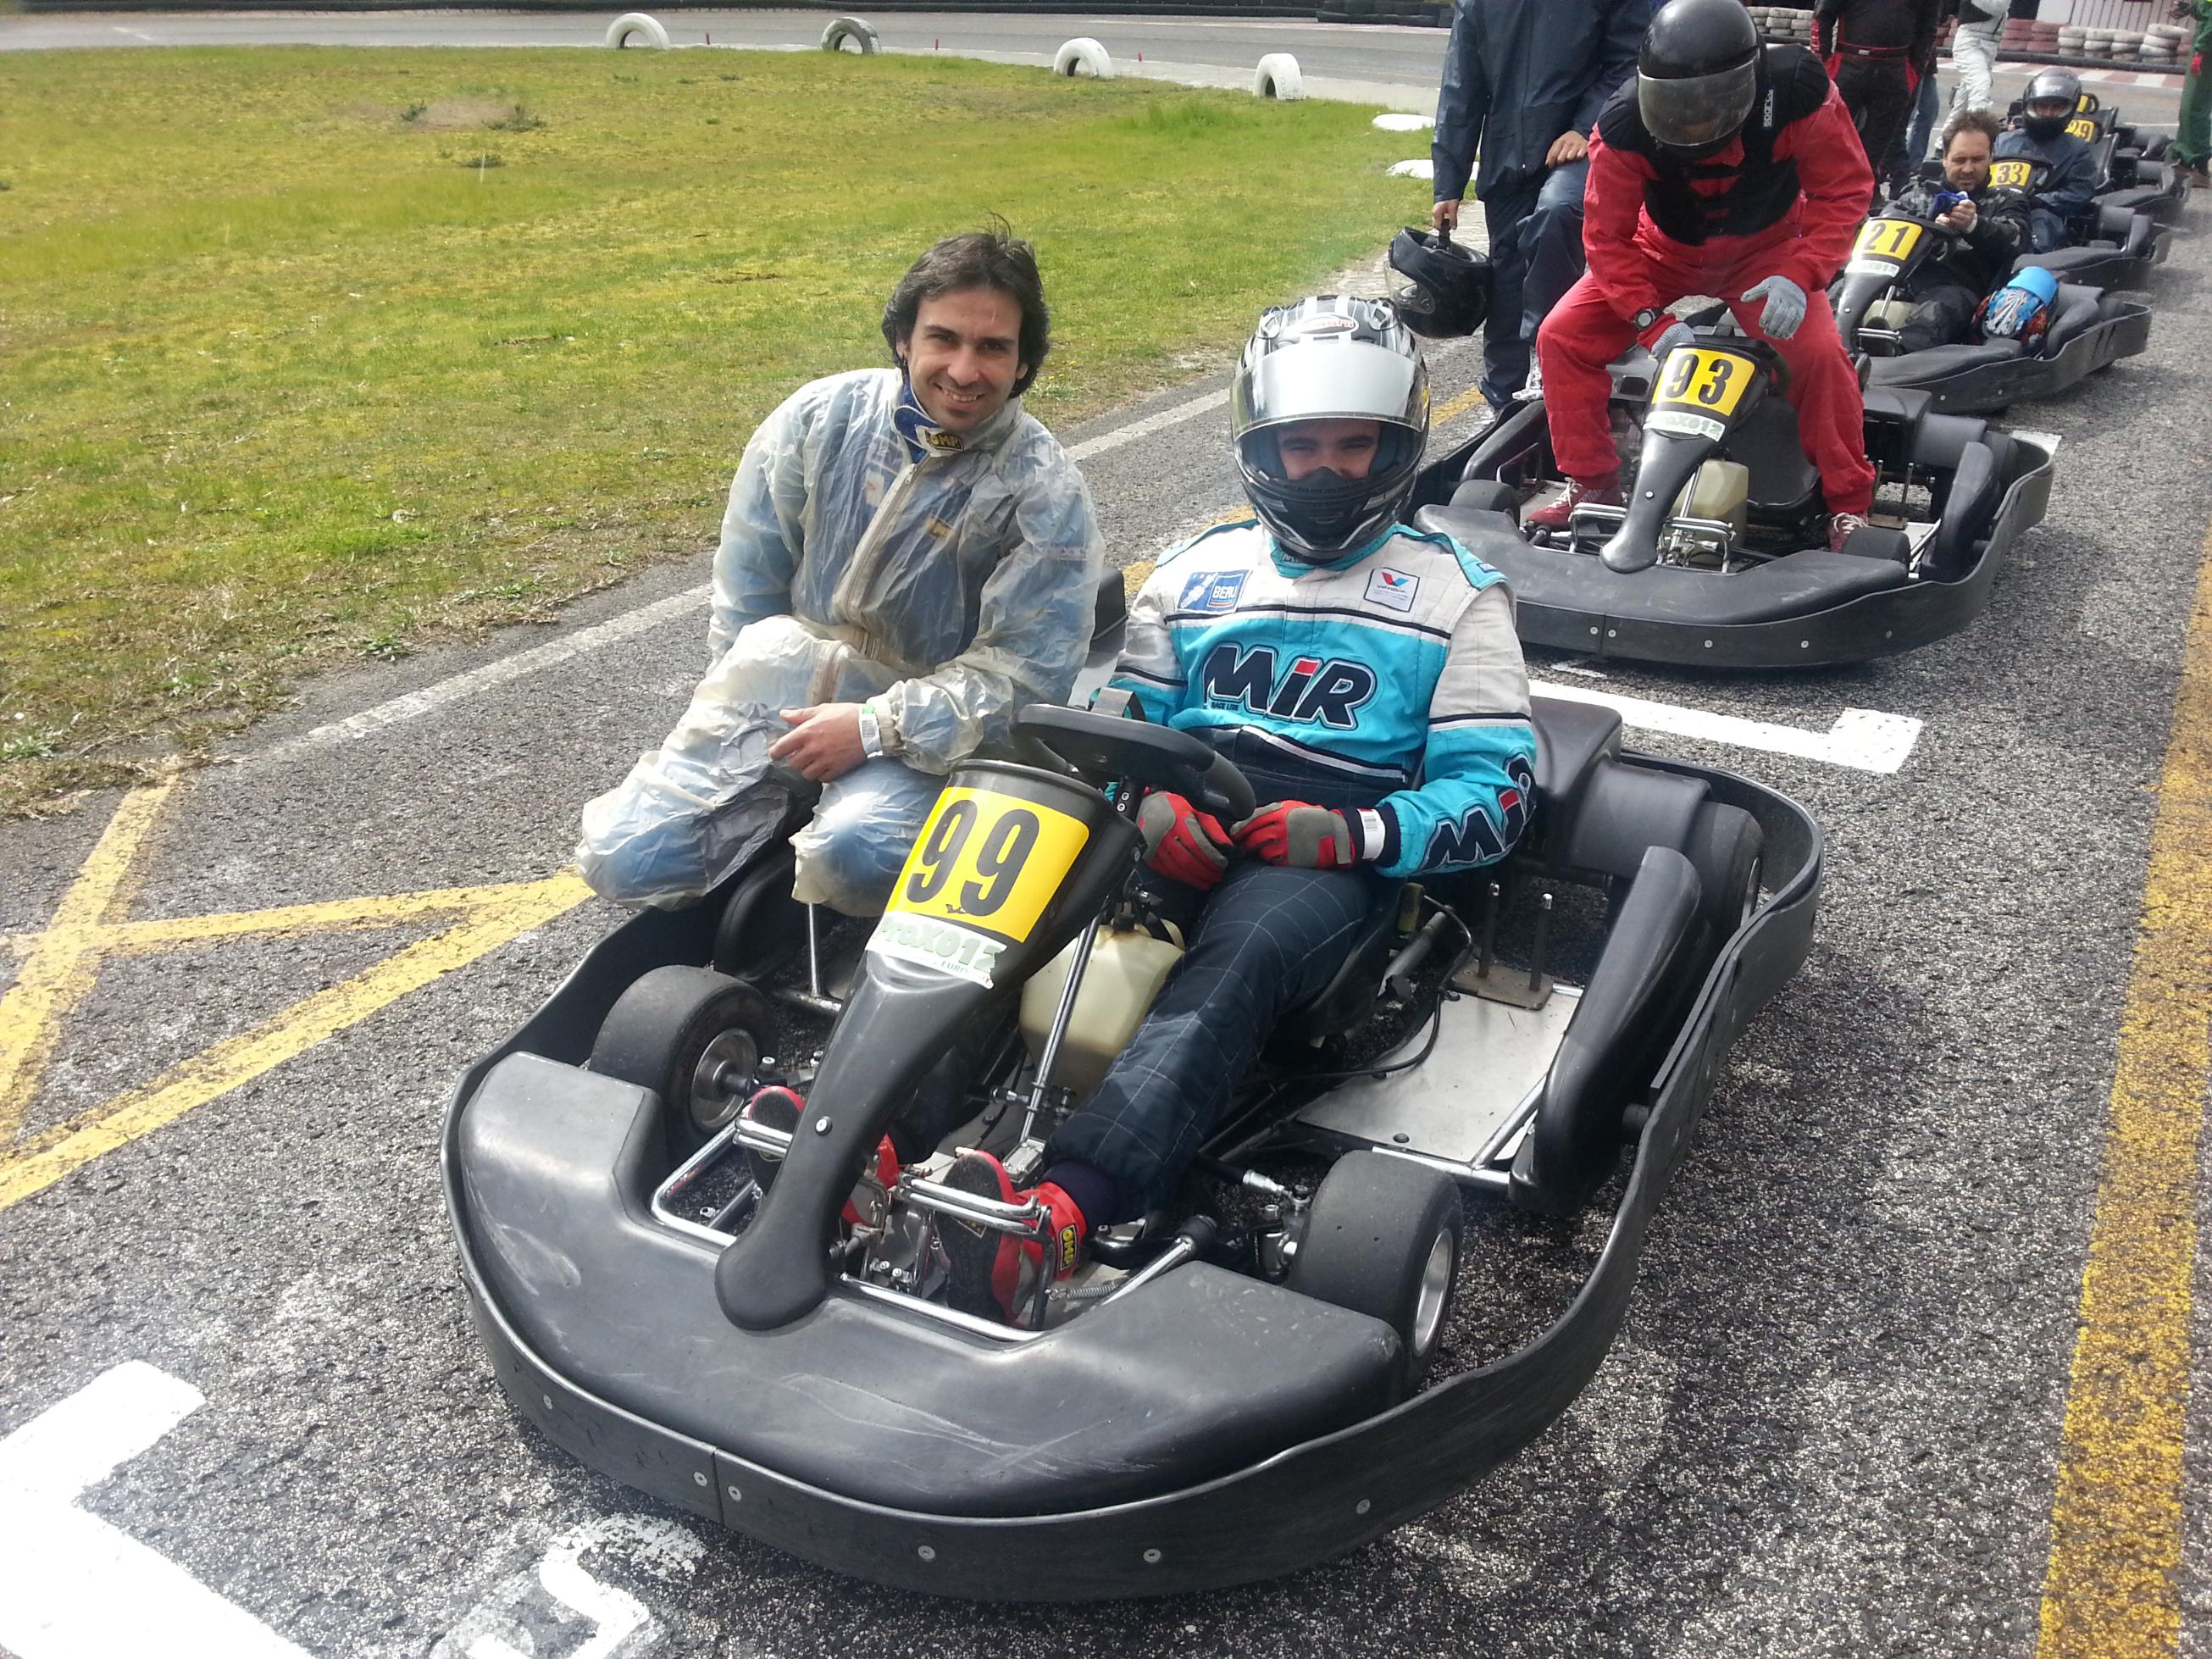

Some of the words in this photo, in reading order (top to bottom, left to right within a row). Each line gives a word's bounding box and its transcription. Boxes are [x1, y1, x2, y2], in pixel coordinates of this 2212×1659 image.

[1997, 164, 2024, 183] 33
[1864, 222, 1910, 252] 21
[1666, 354, 1733, 404] 93
[929, 434, 958, 447] OMP
[1211, 585, 1238, 599] BERU
[906, 800, 1039, 916] 99
[1062, 1229, 1074, 1265] OMP
